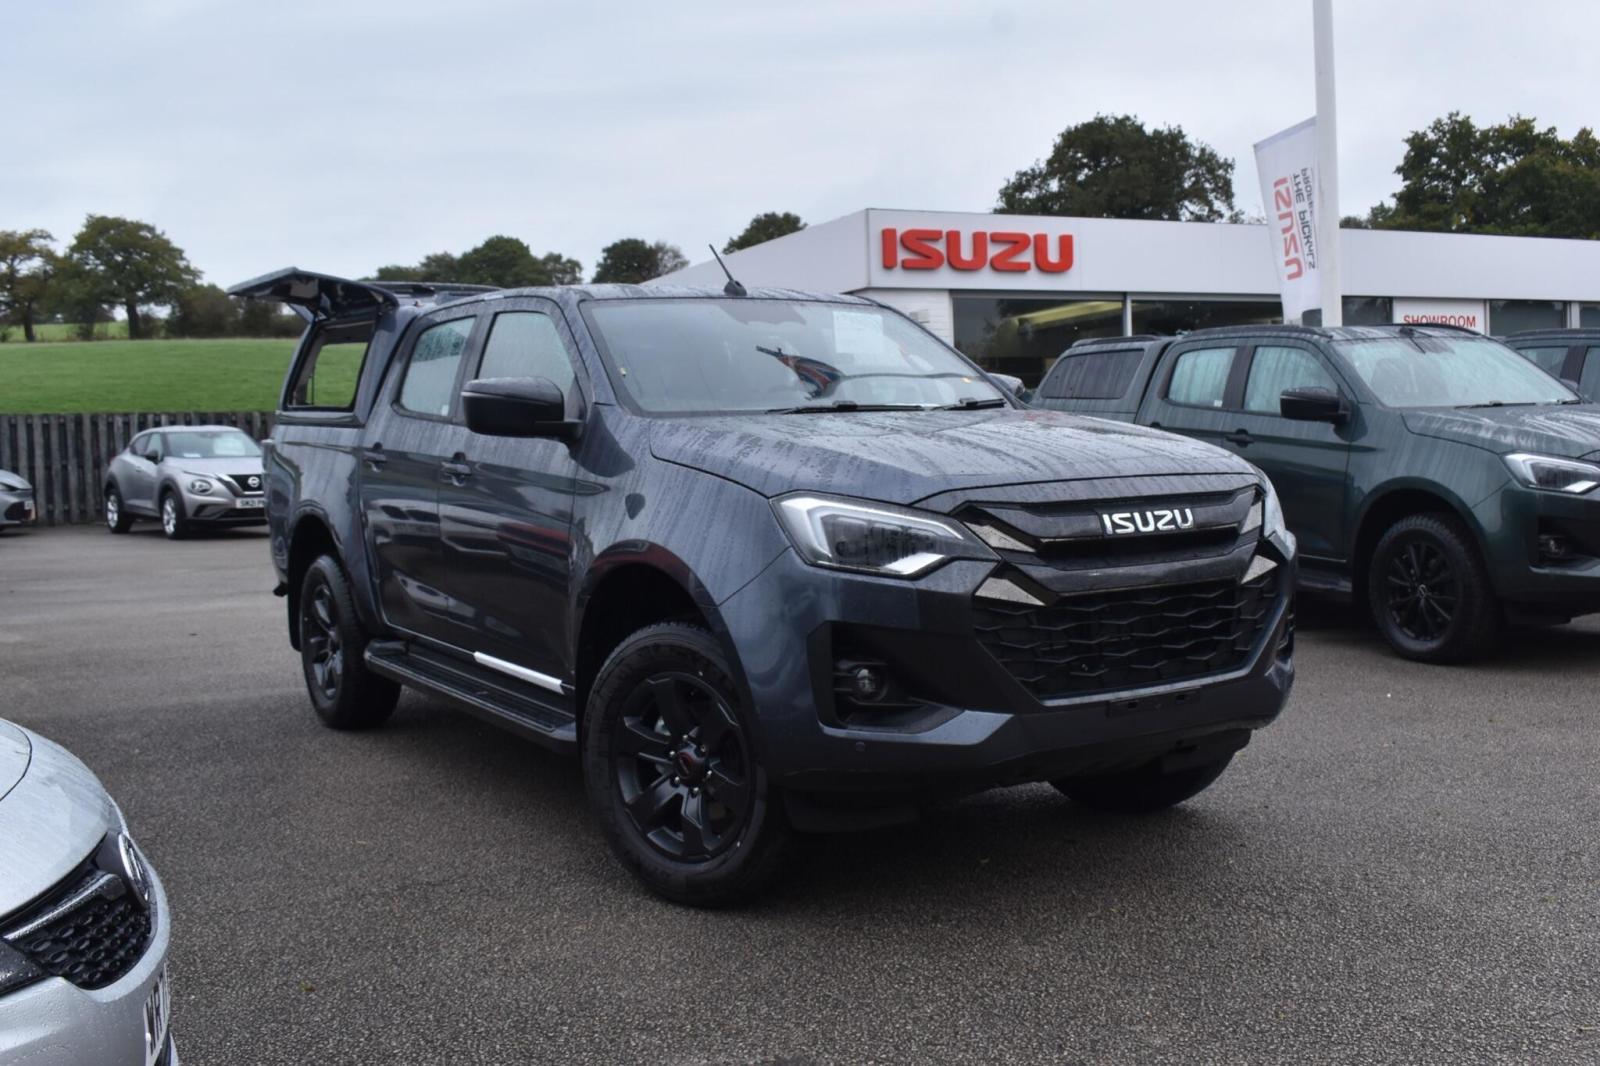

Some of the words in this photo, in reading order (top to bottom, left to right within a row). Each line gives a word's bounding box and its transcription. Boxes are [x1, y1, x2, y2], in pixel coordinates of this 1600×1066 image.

[882, 228, 1074, 273] ISUZU
[1403, 314, 1476, 328] SHOWROOM
[1102, 508, 1194, 535] ISUZU
